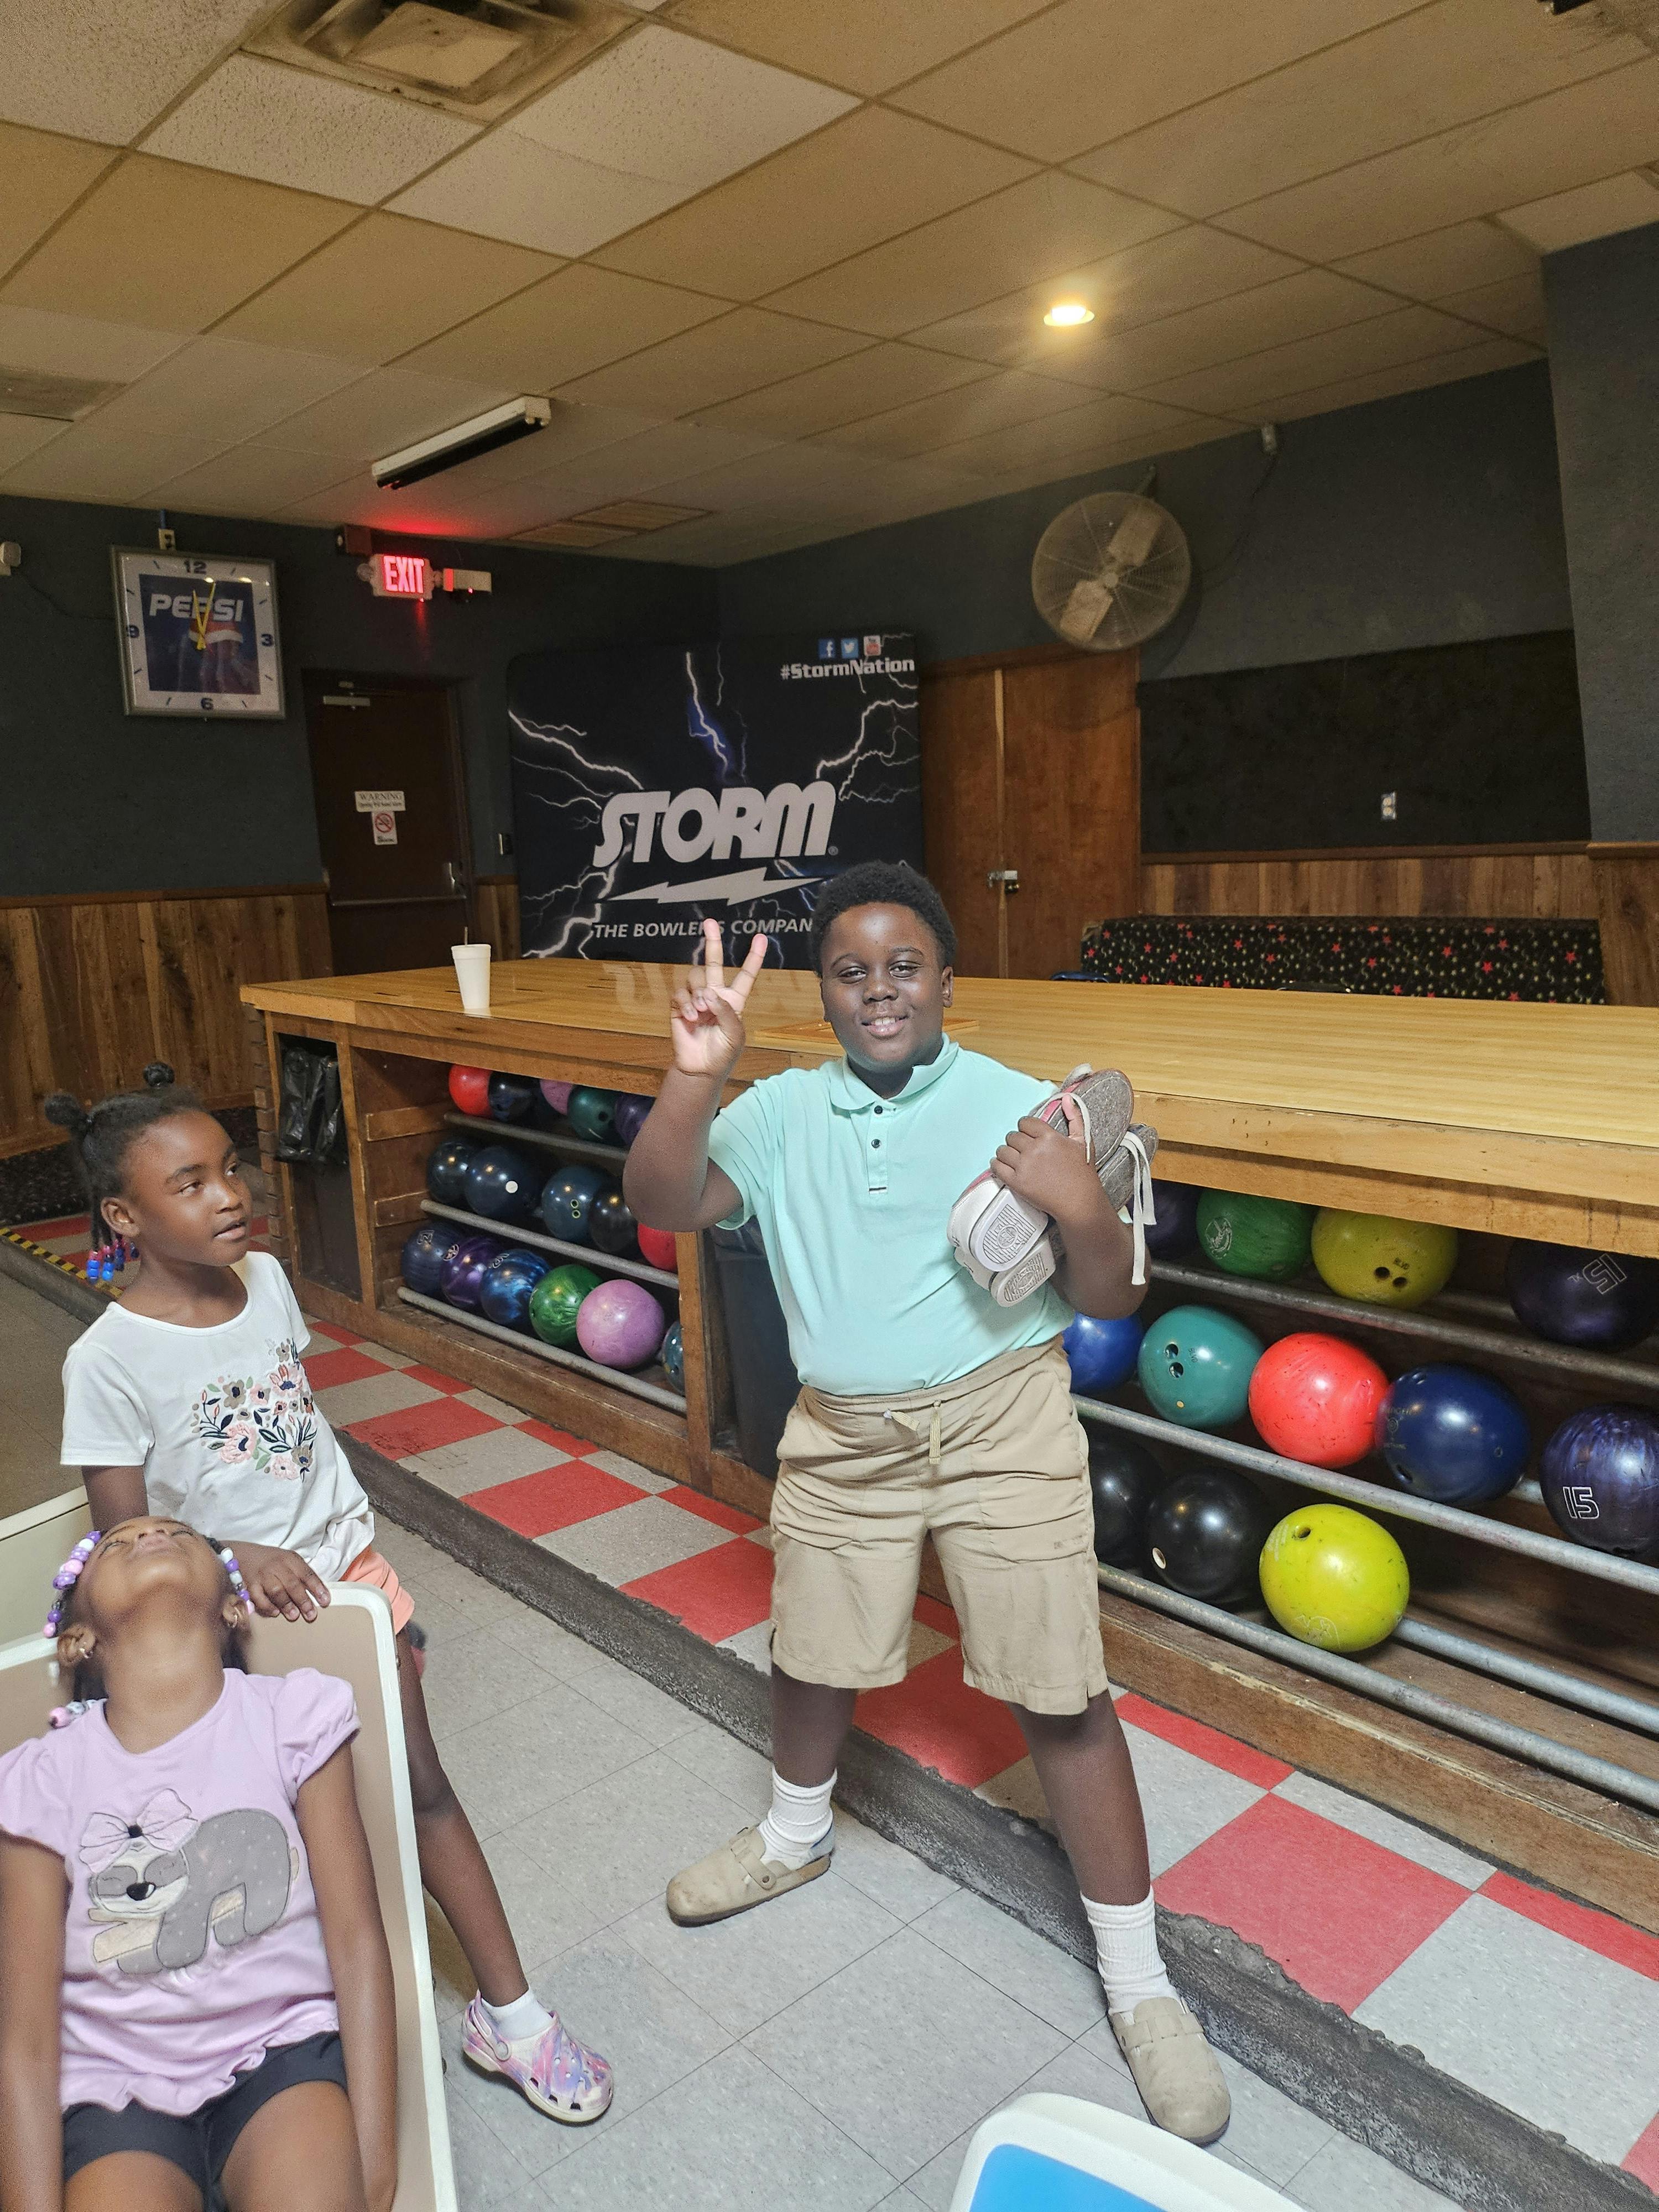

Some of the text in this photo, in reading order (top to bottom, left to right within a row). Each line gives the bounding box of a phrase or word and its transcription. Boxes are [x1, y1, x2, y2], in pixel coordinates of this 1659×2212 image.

[184, 560, 207, 574] 12
[383, 555, 425, 594] EXIT
[126, 625, 139, 638] 9
[261, 634, 273, 646] 3
[780, 657, 915, 680] #StormNation
[201, 697, 214, 710] 6
[594, 924, 628, 938] THE
[731, 917, 813, 935] COMPAN
[1582, 1253, 1627, 1295] 15
[1562, 1486, 1600, 1520] 15
